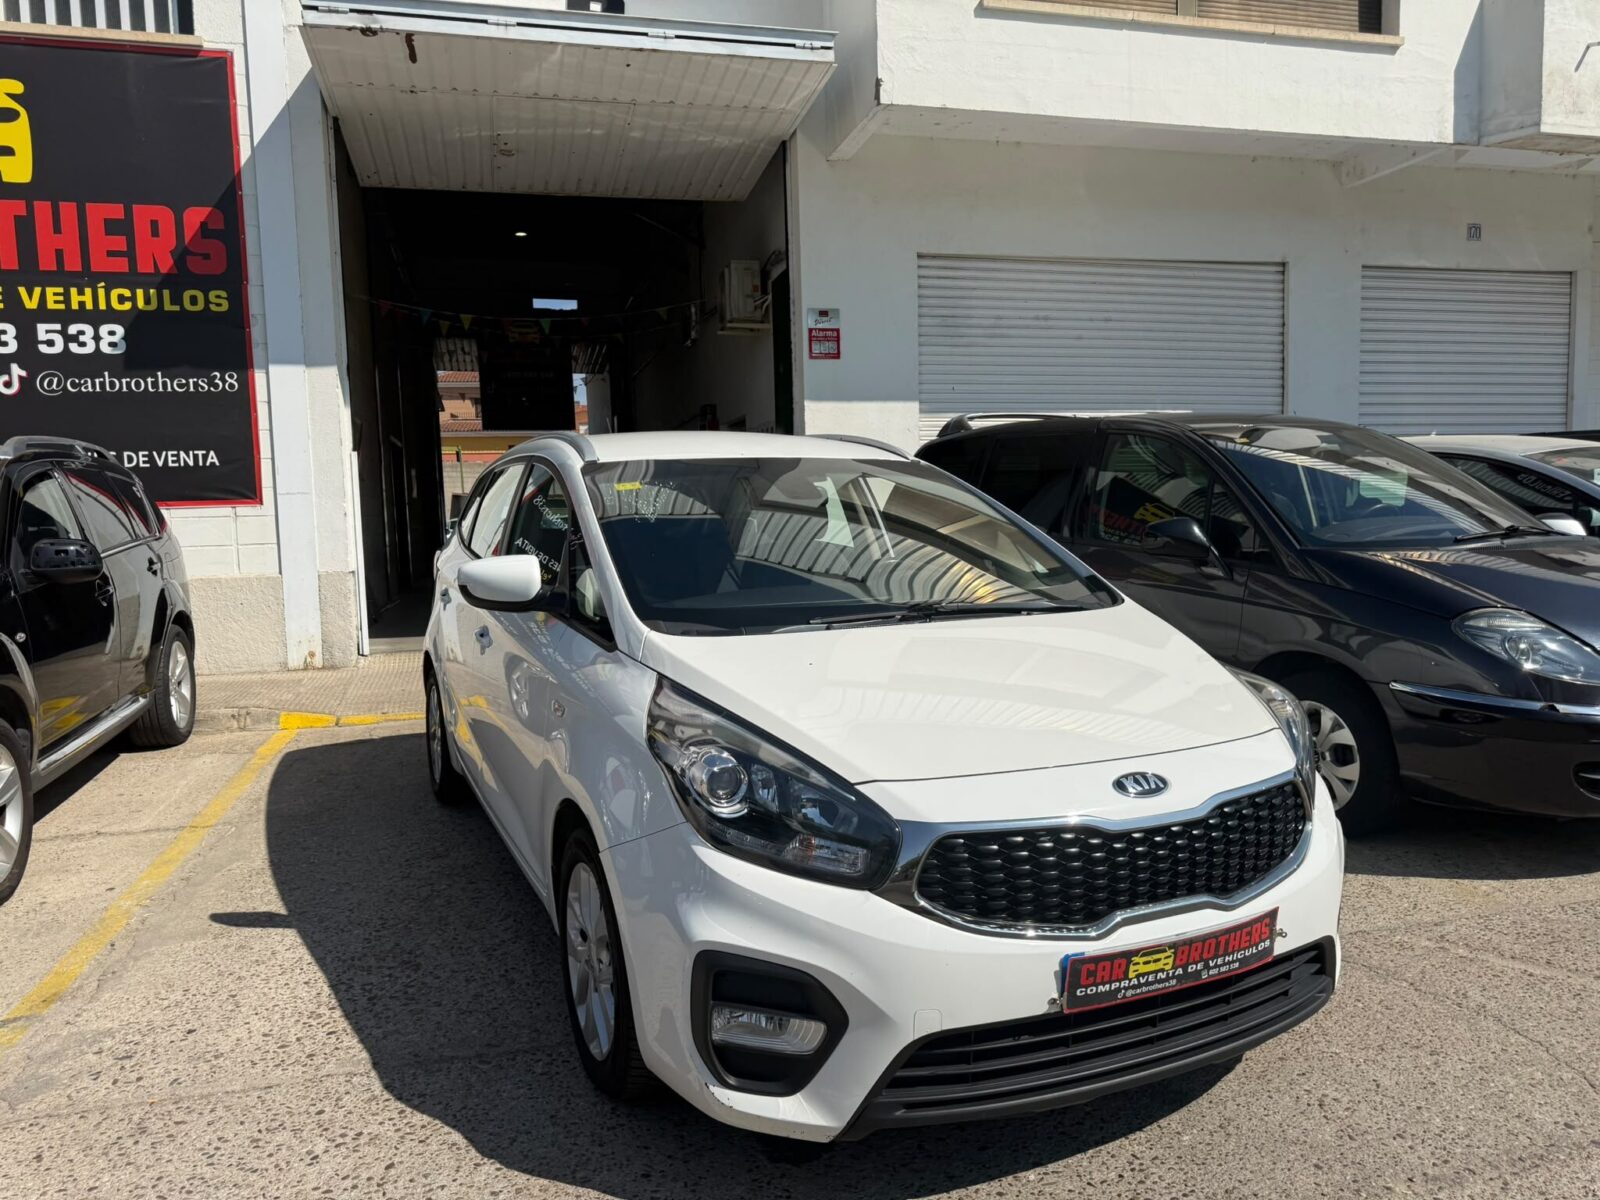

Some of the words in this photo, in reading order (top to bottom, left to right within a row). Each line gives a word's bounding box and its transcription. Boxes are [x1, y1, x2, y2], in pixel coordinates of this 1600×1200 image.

[0, 198, 228, 275] THERS
[18, 282, 230, 312] VEHÍCULOS
[36, 322, 127, 355] 538
[811, 329, 838, 337] Alarma
[36, 370, 239, 396] @carbrothers38
[123, 452, 150, 467] DE
[153, 450, 220, 467] VENTA
[1119, 773, 1165, 793] KIA
[1080, 957, 1128, 986] CAR
[1174, 917, 1271, 967] BROTHERS
[1076, 967, 1183, 997] COMPRAVENTA
[1187, 961, 1205, 973] DE
[1208, 939, 1271, 968] VEHÍCULOS
